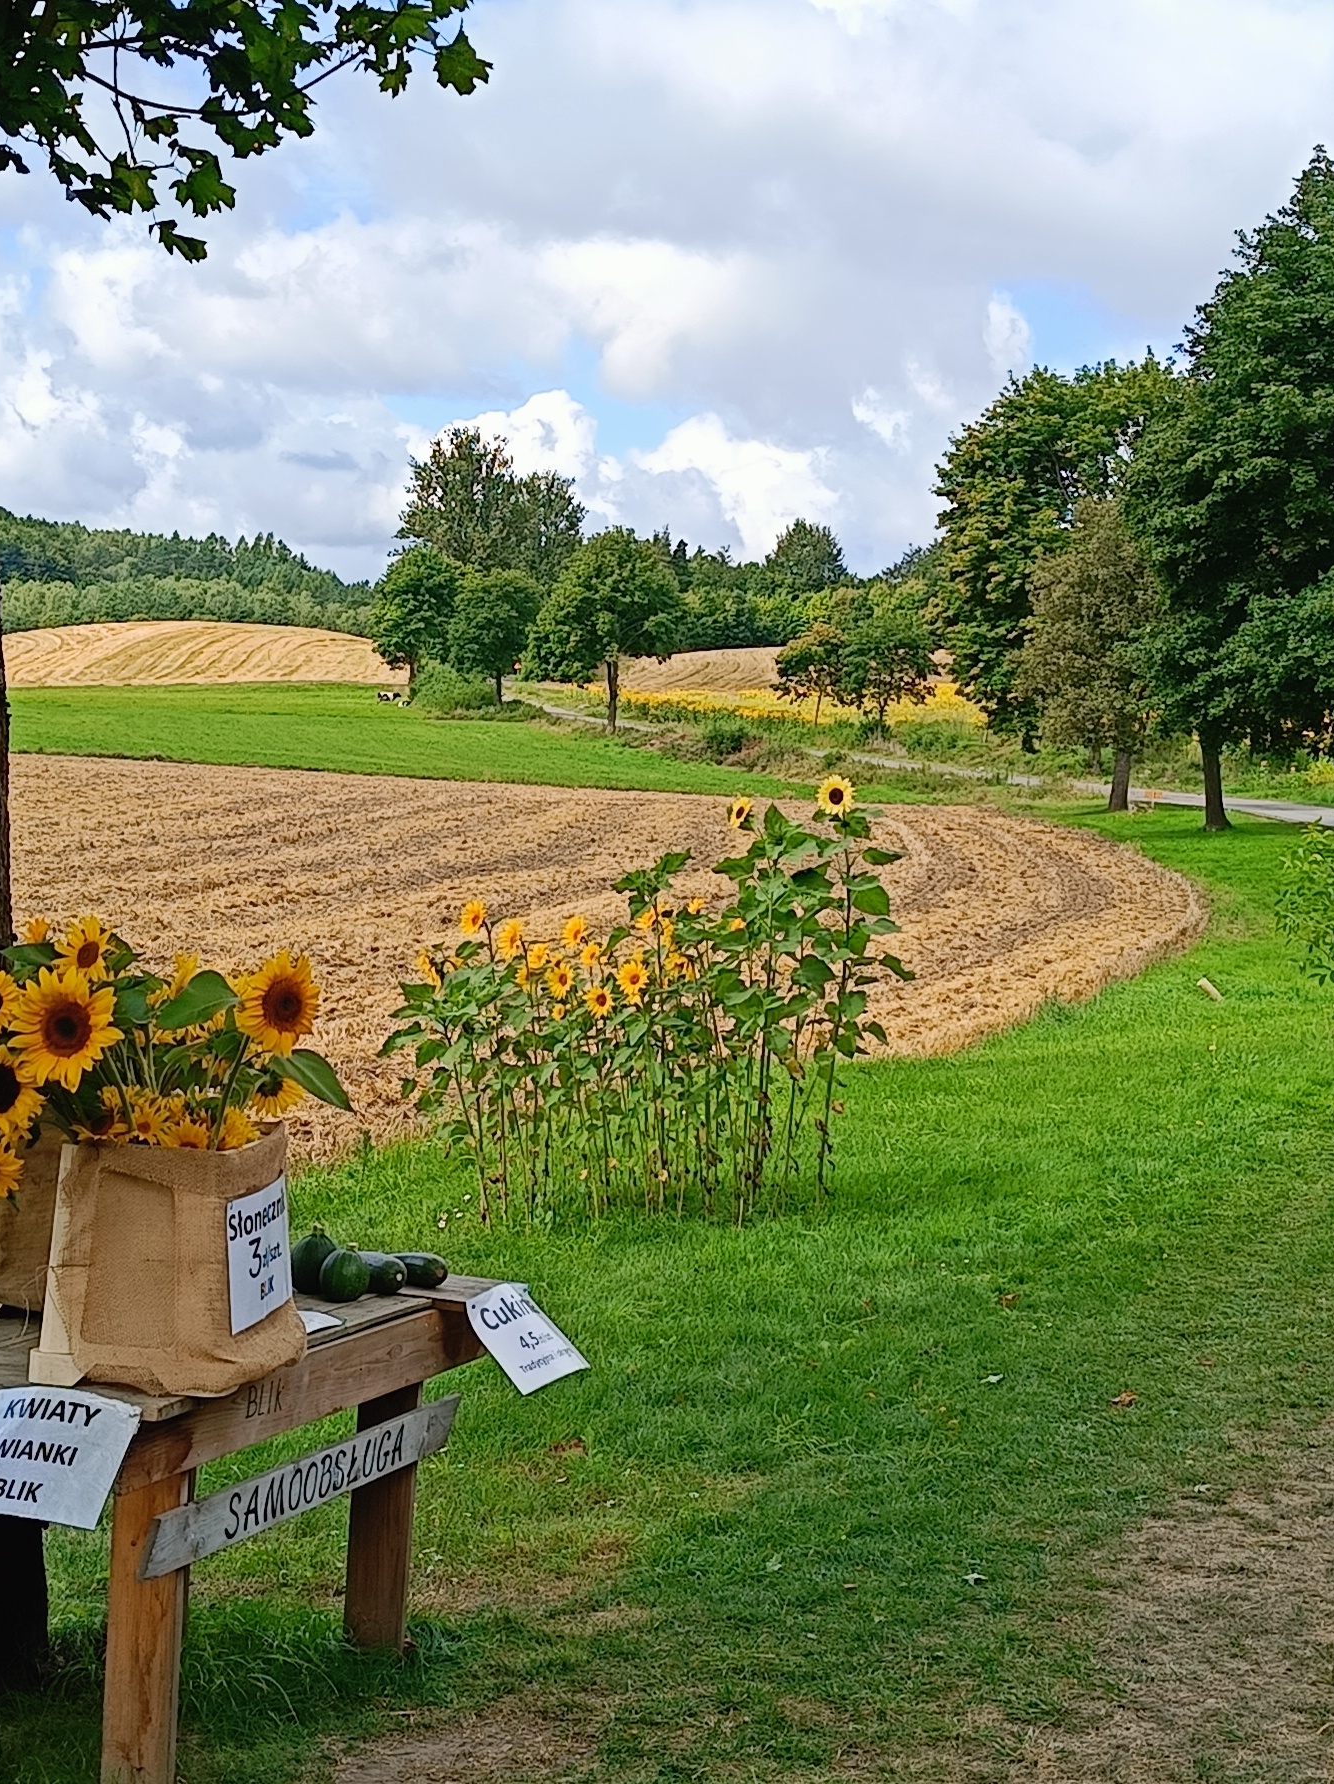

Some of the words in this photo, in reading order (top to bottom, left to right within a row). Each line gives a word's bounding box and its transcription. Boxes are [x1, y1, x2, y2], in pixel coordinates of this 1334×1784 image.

[261, 1275, 274, 1300] BLIK
[3, 1398, 102, 1426] KWIATY
[245, 1378, 285, 1419] BLIK
[224, 1423, 405, 1540] SAMOOBSŁUGA
